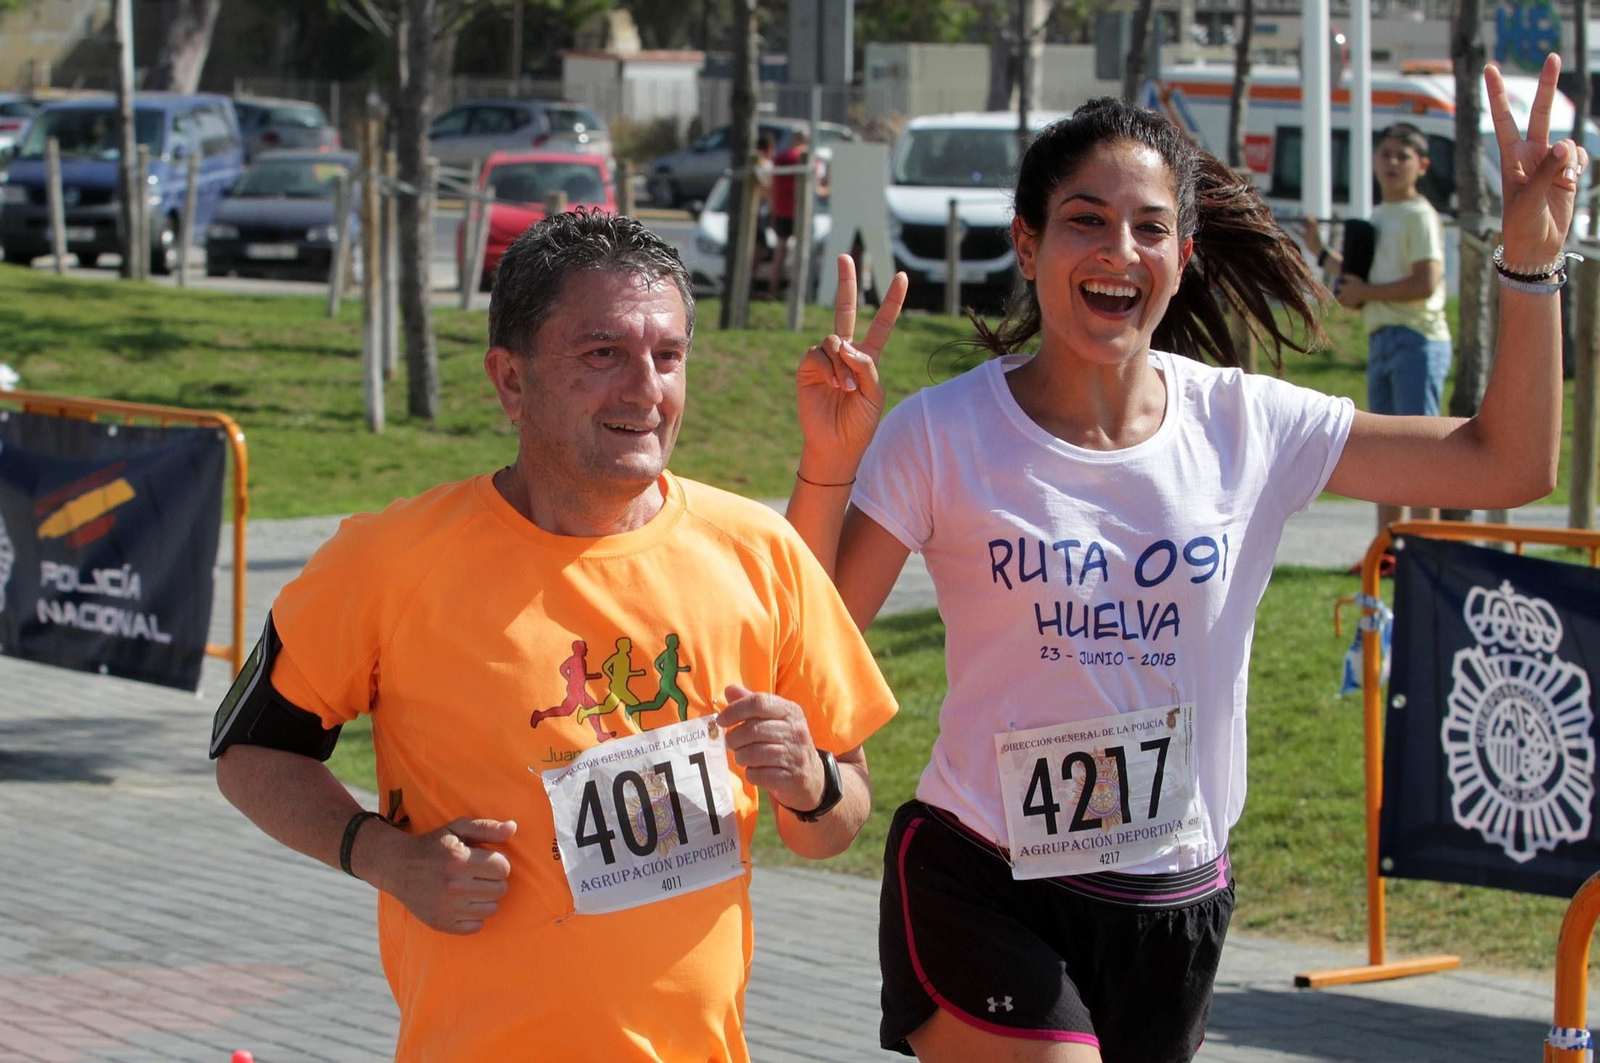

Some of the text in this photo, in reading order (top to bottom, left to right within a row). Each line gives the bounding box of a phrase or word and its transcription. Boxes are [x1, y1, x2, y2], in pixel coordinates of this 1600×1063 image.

[40, 561, 142, 599] POLICÍA
[988, 533, 1229, 590] RUTA 091
[37, 599, 172, 643] NACIONAL
[1034, 600, 1180, 641] HUELVA
[1040, 646, 1061, 661] 23
[1079, 651, 1124, 666] JUNIO
[1140, 652, 1177, 666] 2018
[1003, 718, 1165, 752] DIRECCIÓN GENERAL DE LA POLICÍA
[552, 729, 707, 785] DCCIÓN GENERAL DE LA POLICÍA
[1022, 736, 1172, 836] 4217
[575, 751, 721, 866] 4011
[1019, 820, 1184, 857] AGRUPACIÓN DEPORTIVA
[1099, 851, 1120, 865] 4217
[580, 838, 737, 893] AGRUPACIÓN DEPORTIVA
[661, 875, 682, 892] 4011
